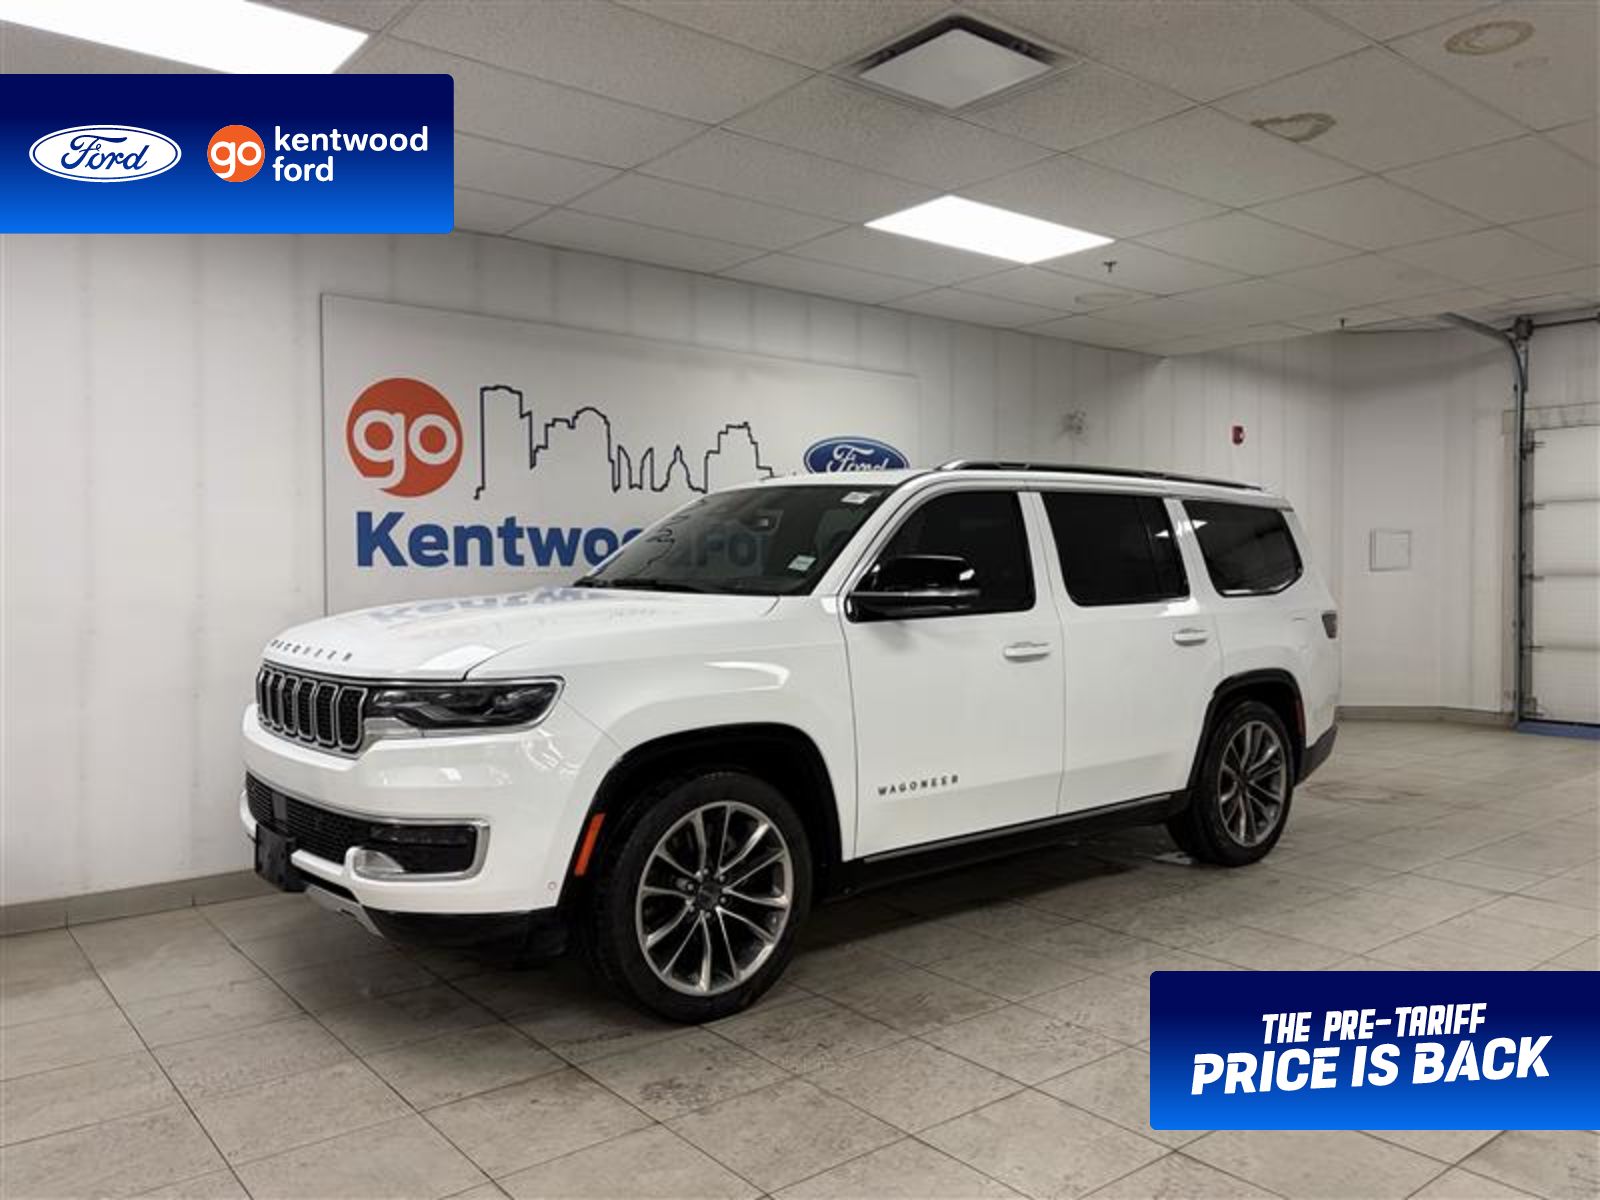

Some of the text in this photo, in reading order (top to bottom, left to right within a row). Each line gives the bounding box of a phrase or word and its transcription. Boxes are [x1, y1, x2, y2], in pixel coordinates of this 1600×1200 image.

[352, 409, 460, 490] go
[356, 511, 646, 568] Kentwo
[877, 774, 959, 796] WAGONEER
